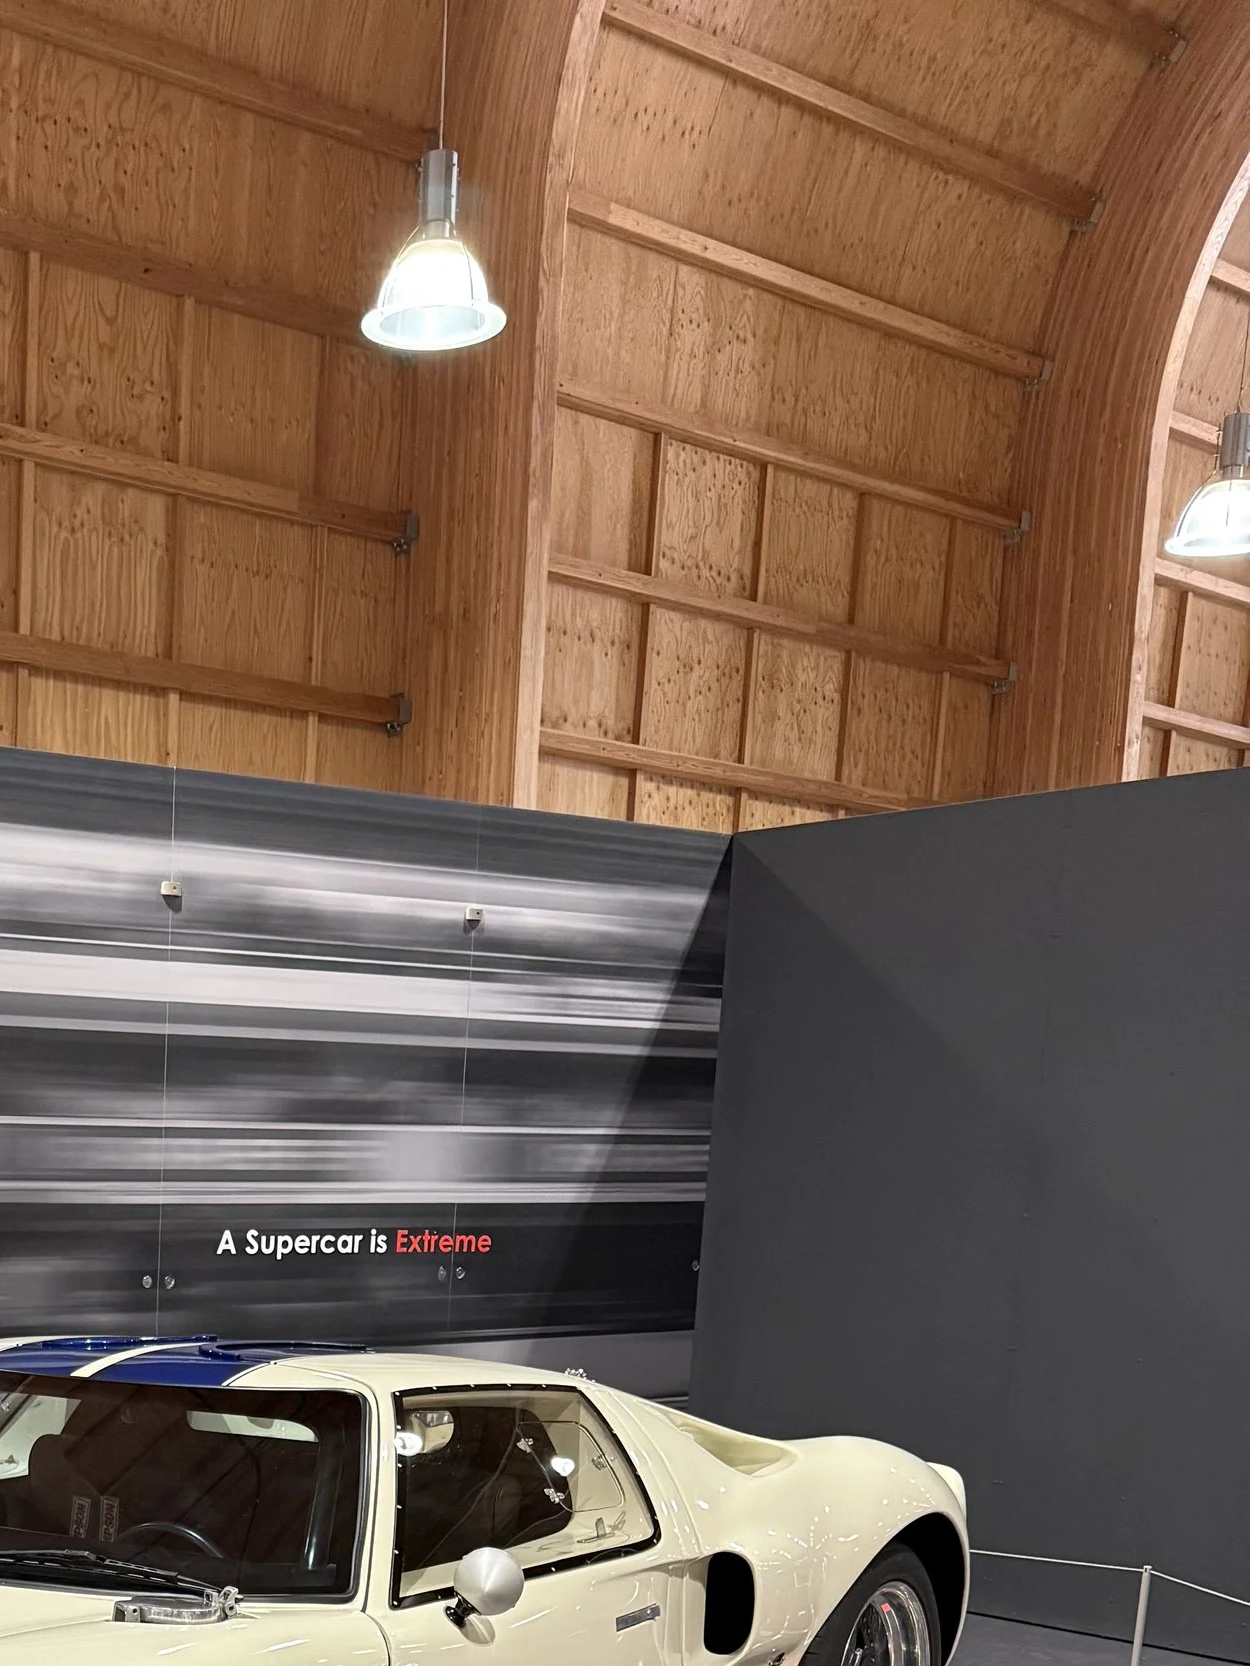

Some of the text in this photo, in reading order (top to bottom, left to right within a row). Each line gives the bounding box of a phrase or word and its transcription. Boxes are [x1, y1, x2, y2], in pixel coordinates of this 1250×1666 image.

[216, 1228, 491, 1259] A Supercar is Extreme
